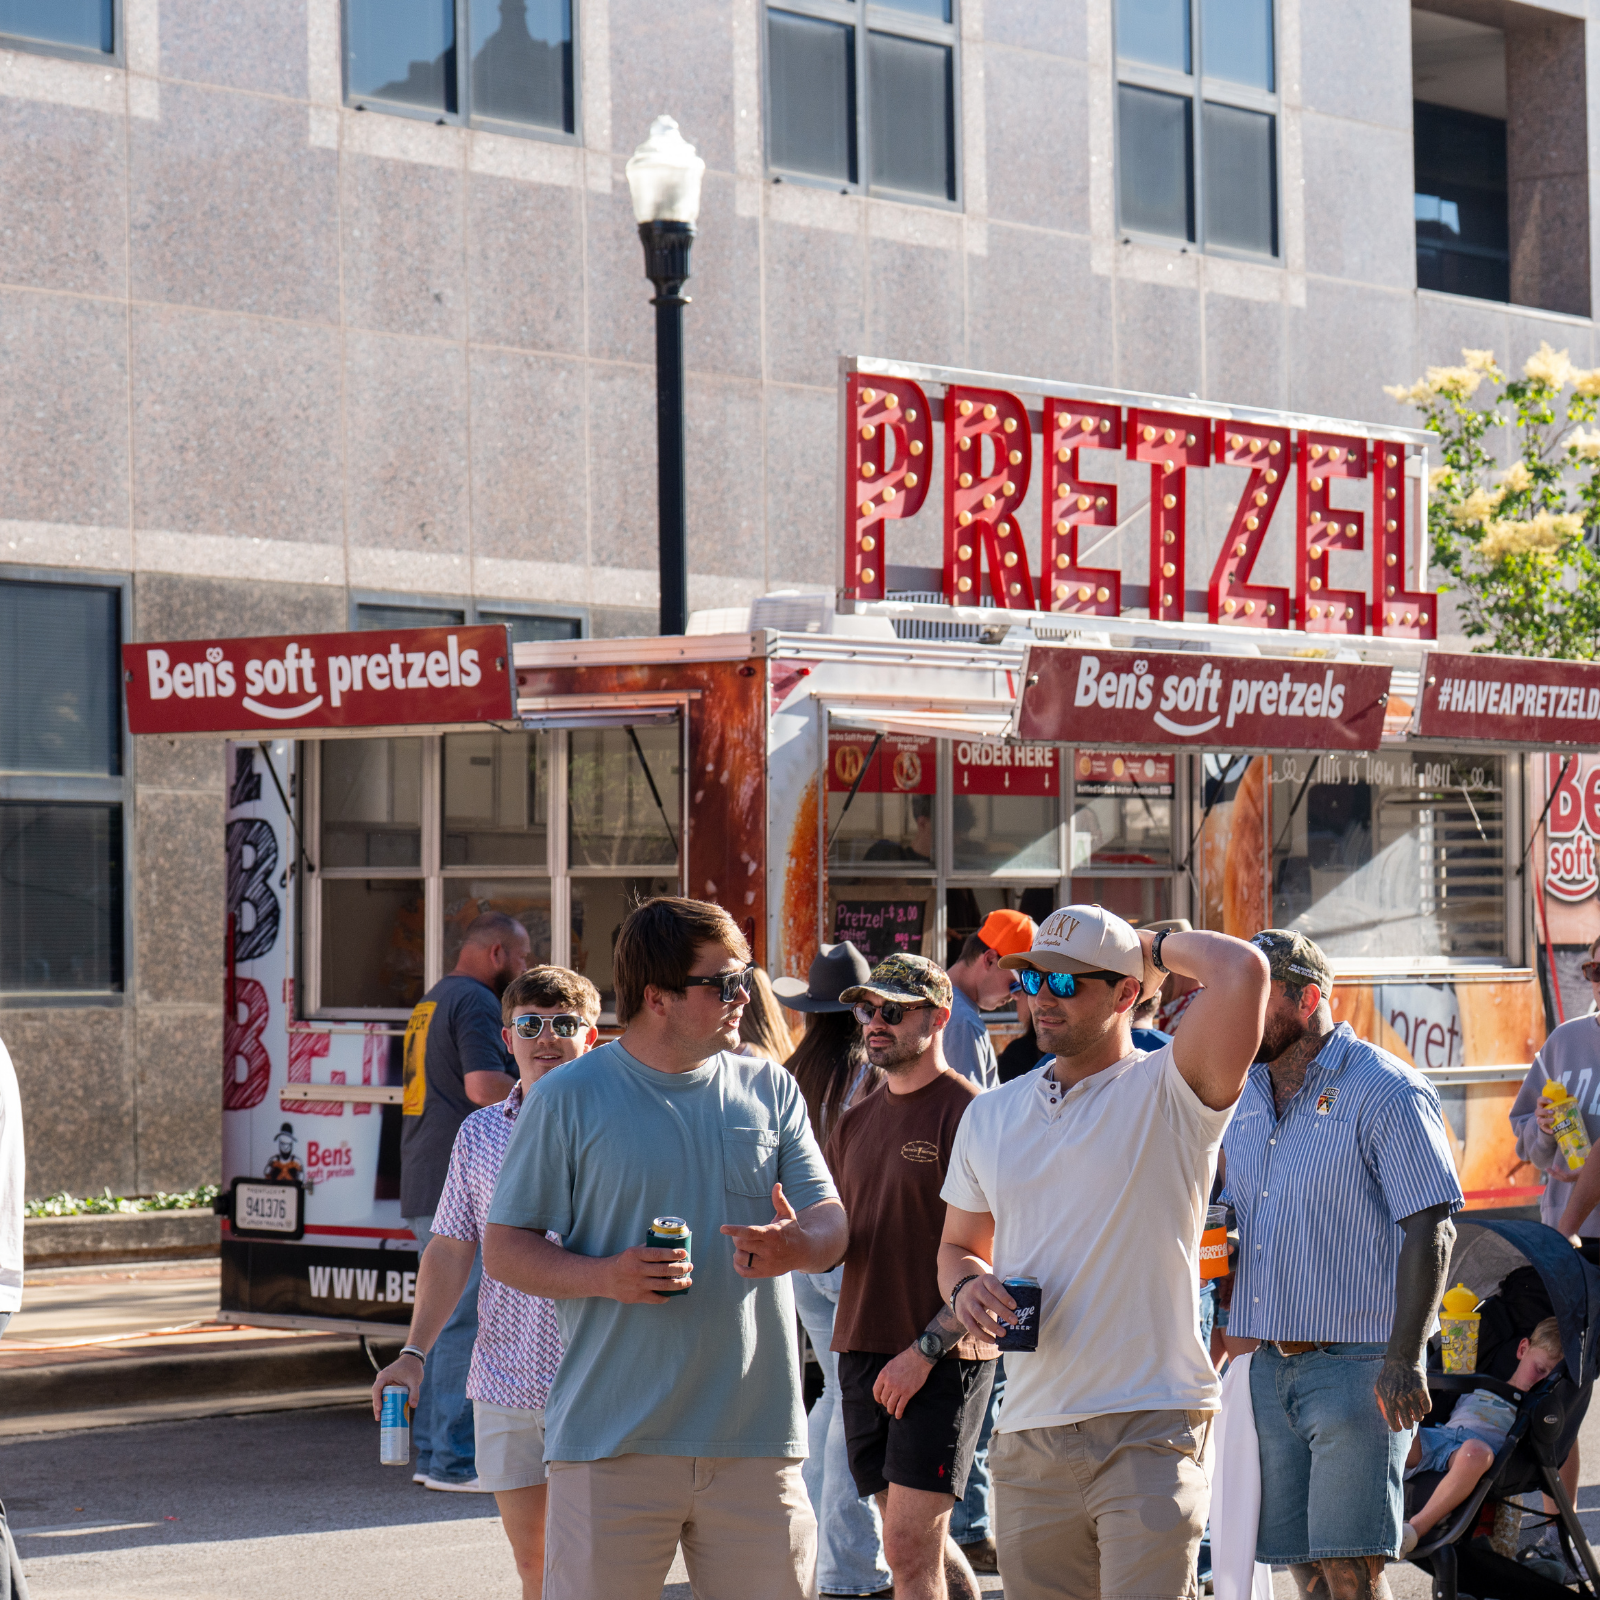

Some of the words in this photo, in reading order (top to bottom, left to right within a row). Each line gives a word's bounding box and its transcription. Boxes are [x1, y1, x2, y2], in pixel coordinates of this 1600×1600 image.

[846, 372, 1437, 640] PRETZEL
[245, 642, 317, 697] soft
[328, 634, 482, 708] pretzels
[1160, 663, 1222, 713] soft
[1226, 669, 1346, 728] pretzels
[1438, 678, 1600, 720] #HAVEAPRETZELD
[957, 742, 1012, 766] ORDER
[1014, 746, 1053, 767] HERE
[1348, 759, 1359, 785] IS
[1366, 757, 1395, 786] HOW
[1401, 762, 1418, 787] WE
[1550, 834, 1594, 878] soft
[246, 1196, 286, 1220] 941376
